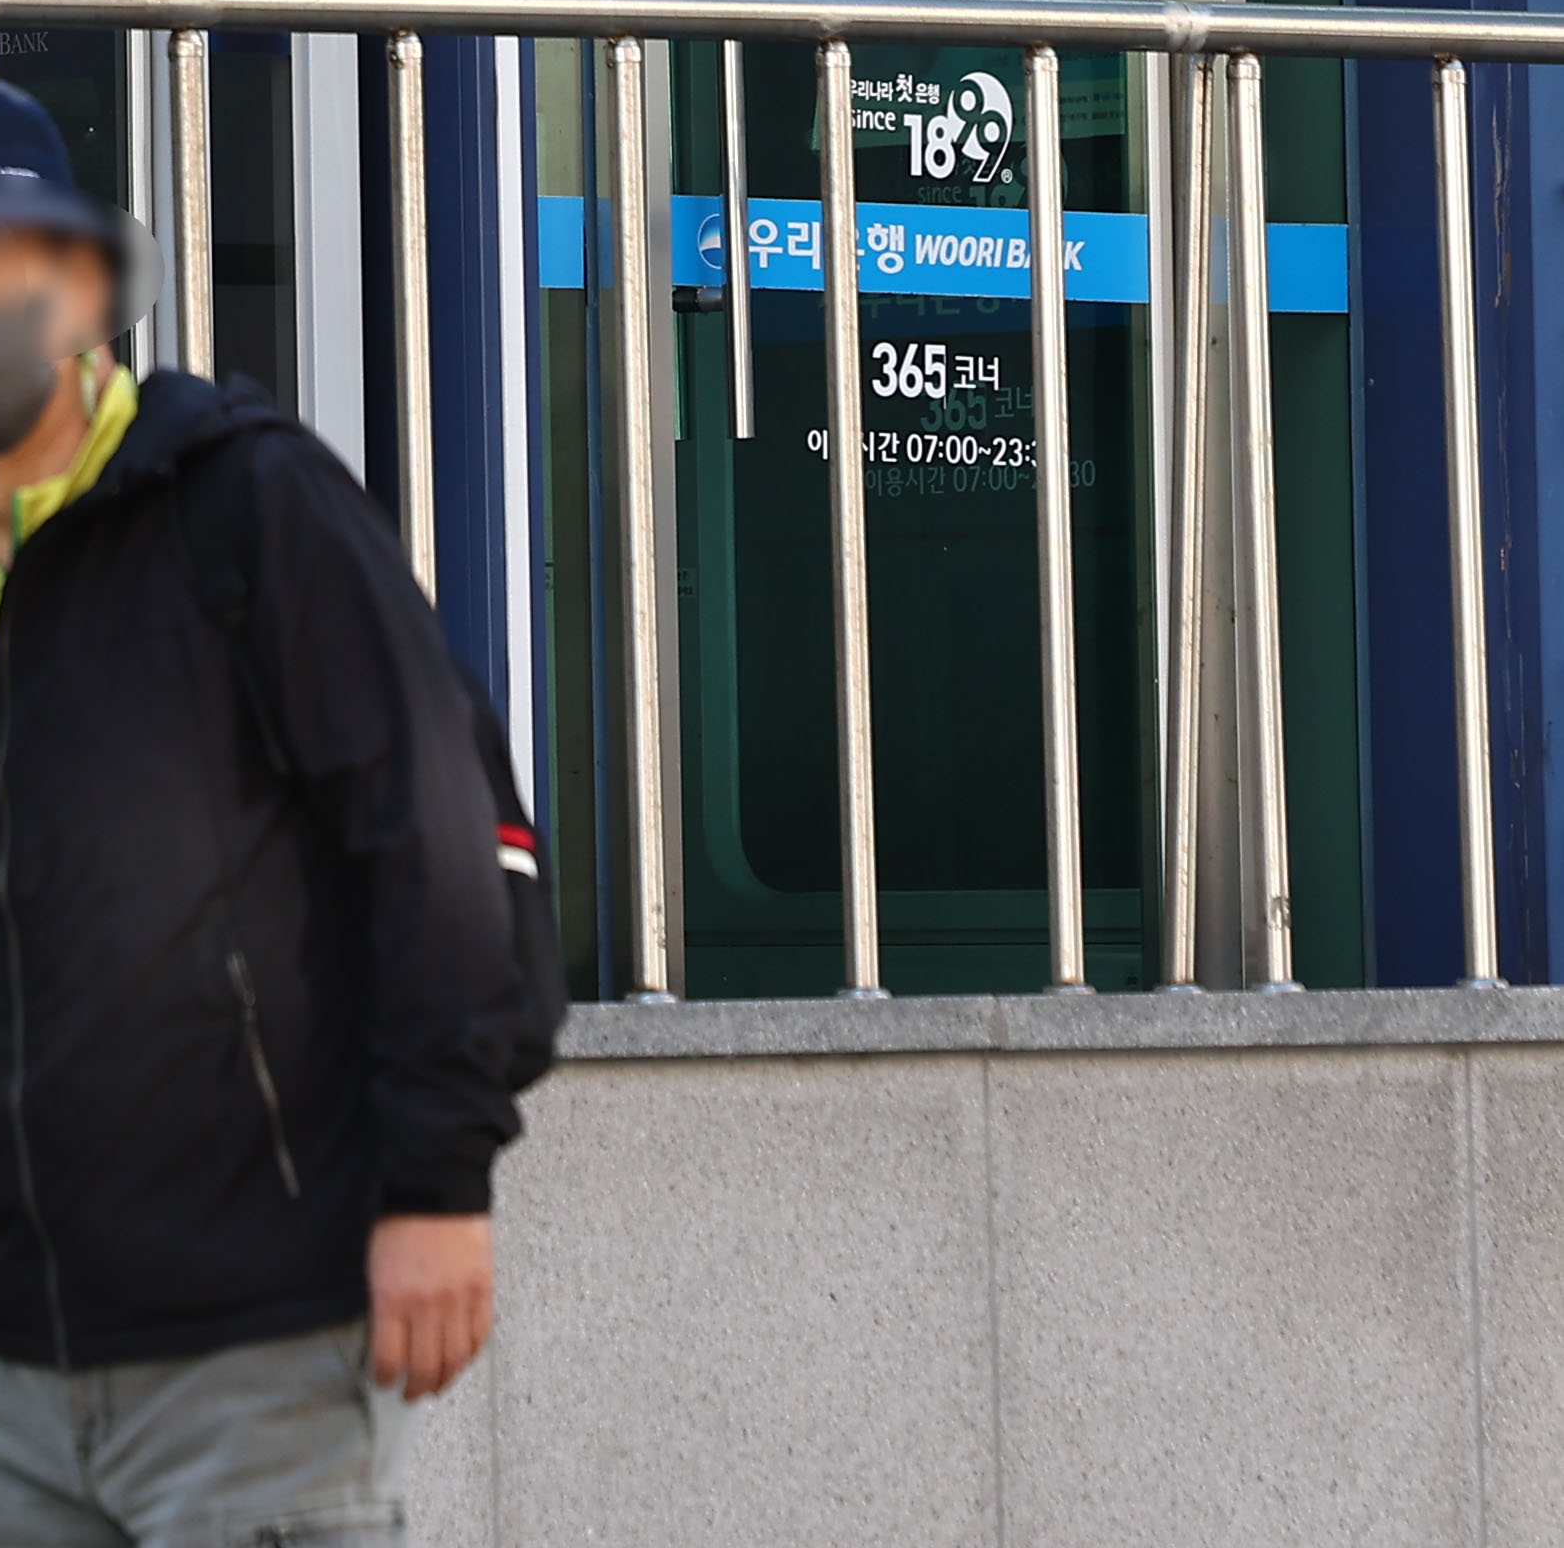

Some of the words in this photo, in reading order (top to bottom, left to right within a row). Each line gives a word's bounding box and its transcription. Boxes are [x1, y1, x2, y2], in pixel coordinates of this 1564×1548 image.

[895, 72, 913, 103] 첫
[915, 82, 941, 104] 은행
[748, 217, 905, 274] 우리행
[914, 233, 1002, 268] WOORI
[1006, 238, 1087, 272] BK
[871, 341, 947, 399] 365
[953, 354, 1000, 392] 코너
[807, 428, 900, 464] 이시간
[906, 433, 1038, 468] 07:00~23:
